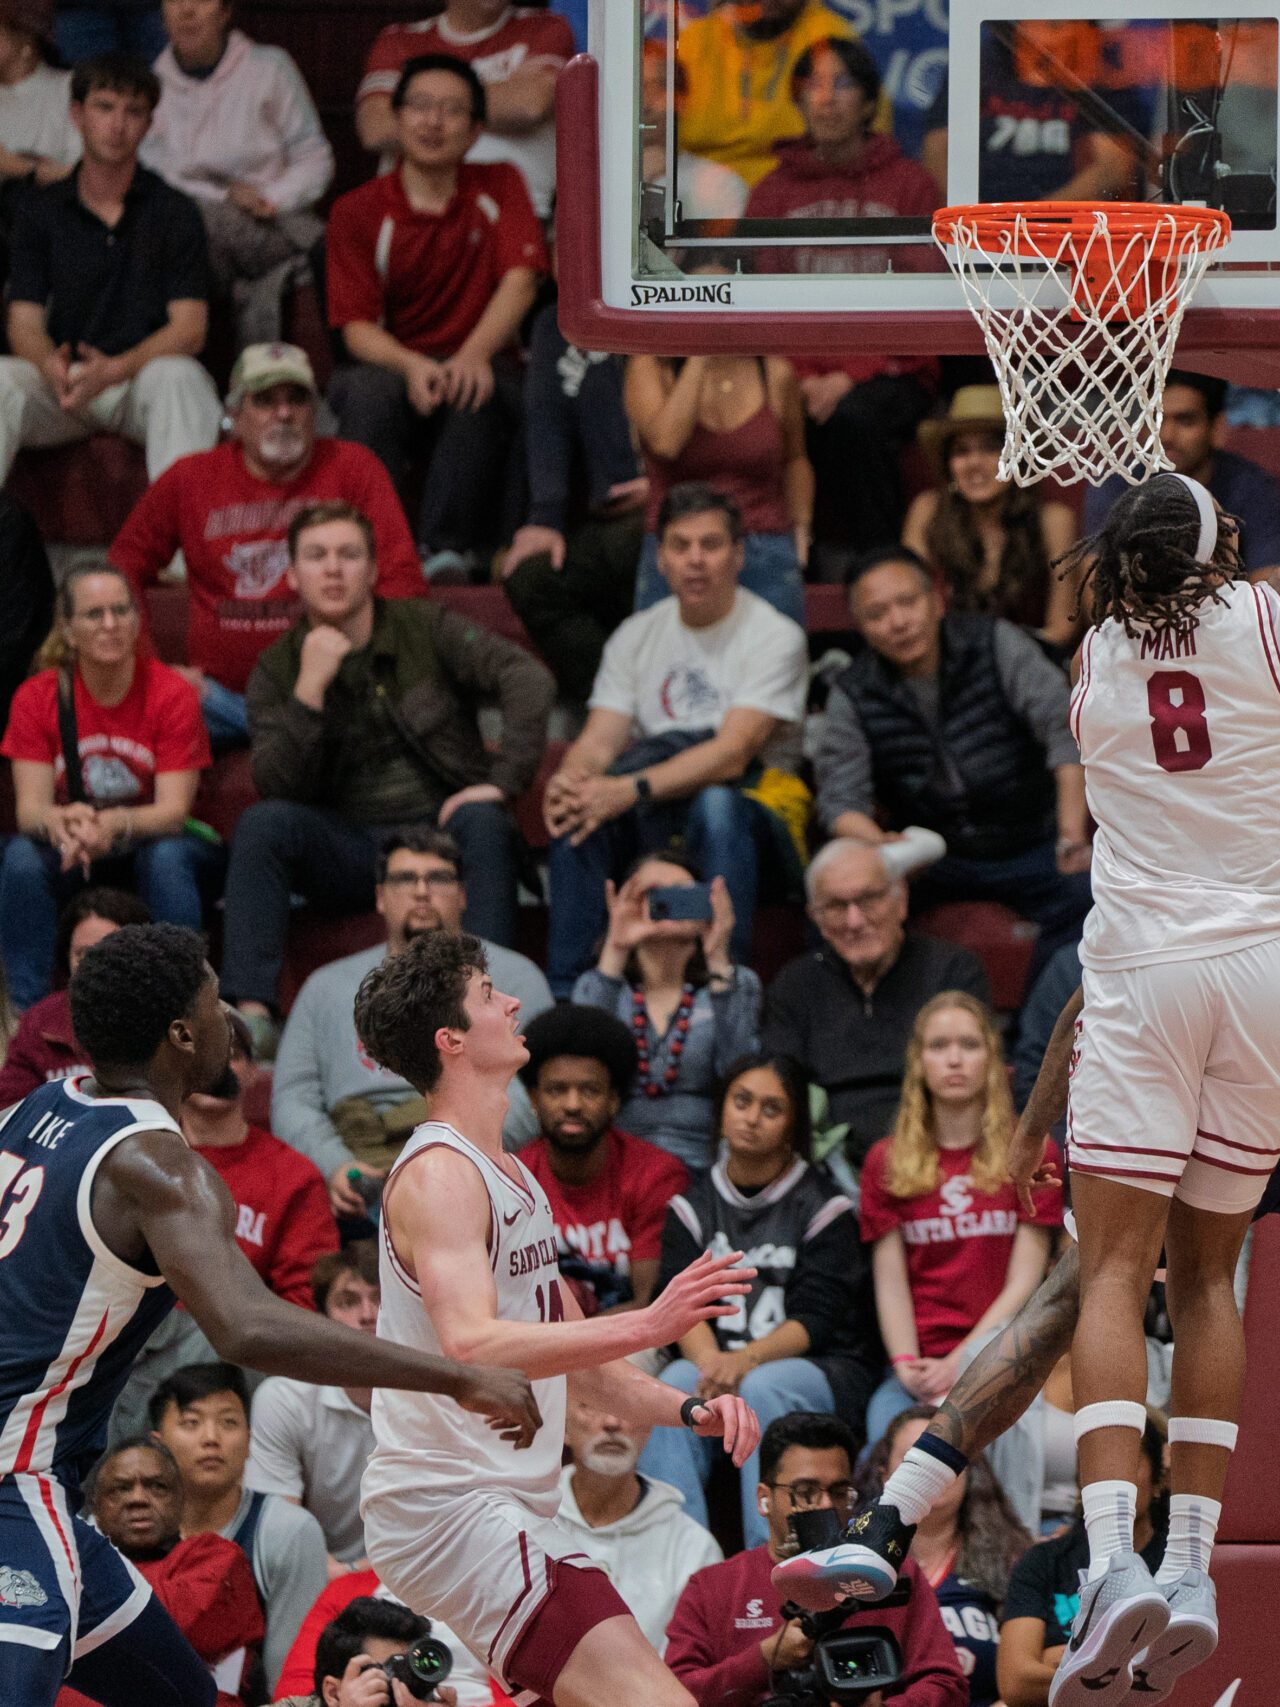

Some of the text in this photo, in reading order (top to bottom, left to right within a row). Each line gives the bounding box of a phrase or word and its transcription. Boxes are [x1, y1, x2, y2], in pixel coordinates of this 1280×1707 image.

[631, 282, 732, 307] SPALDING
[1147, 670, 1212, 773] 8
[28, 1111, 74, 1149] IKE
